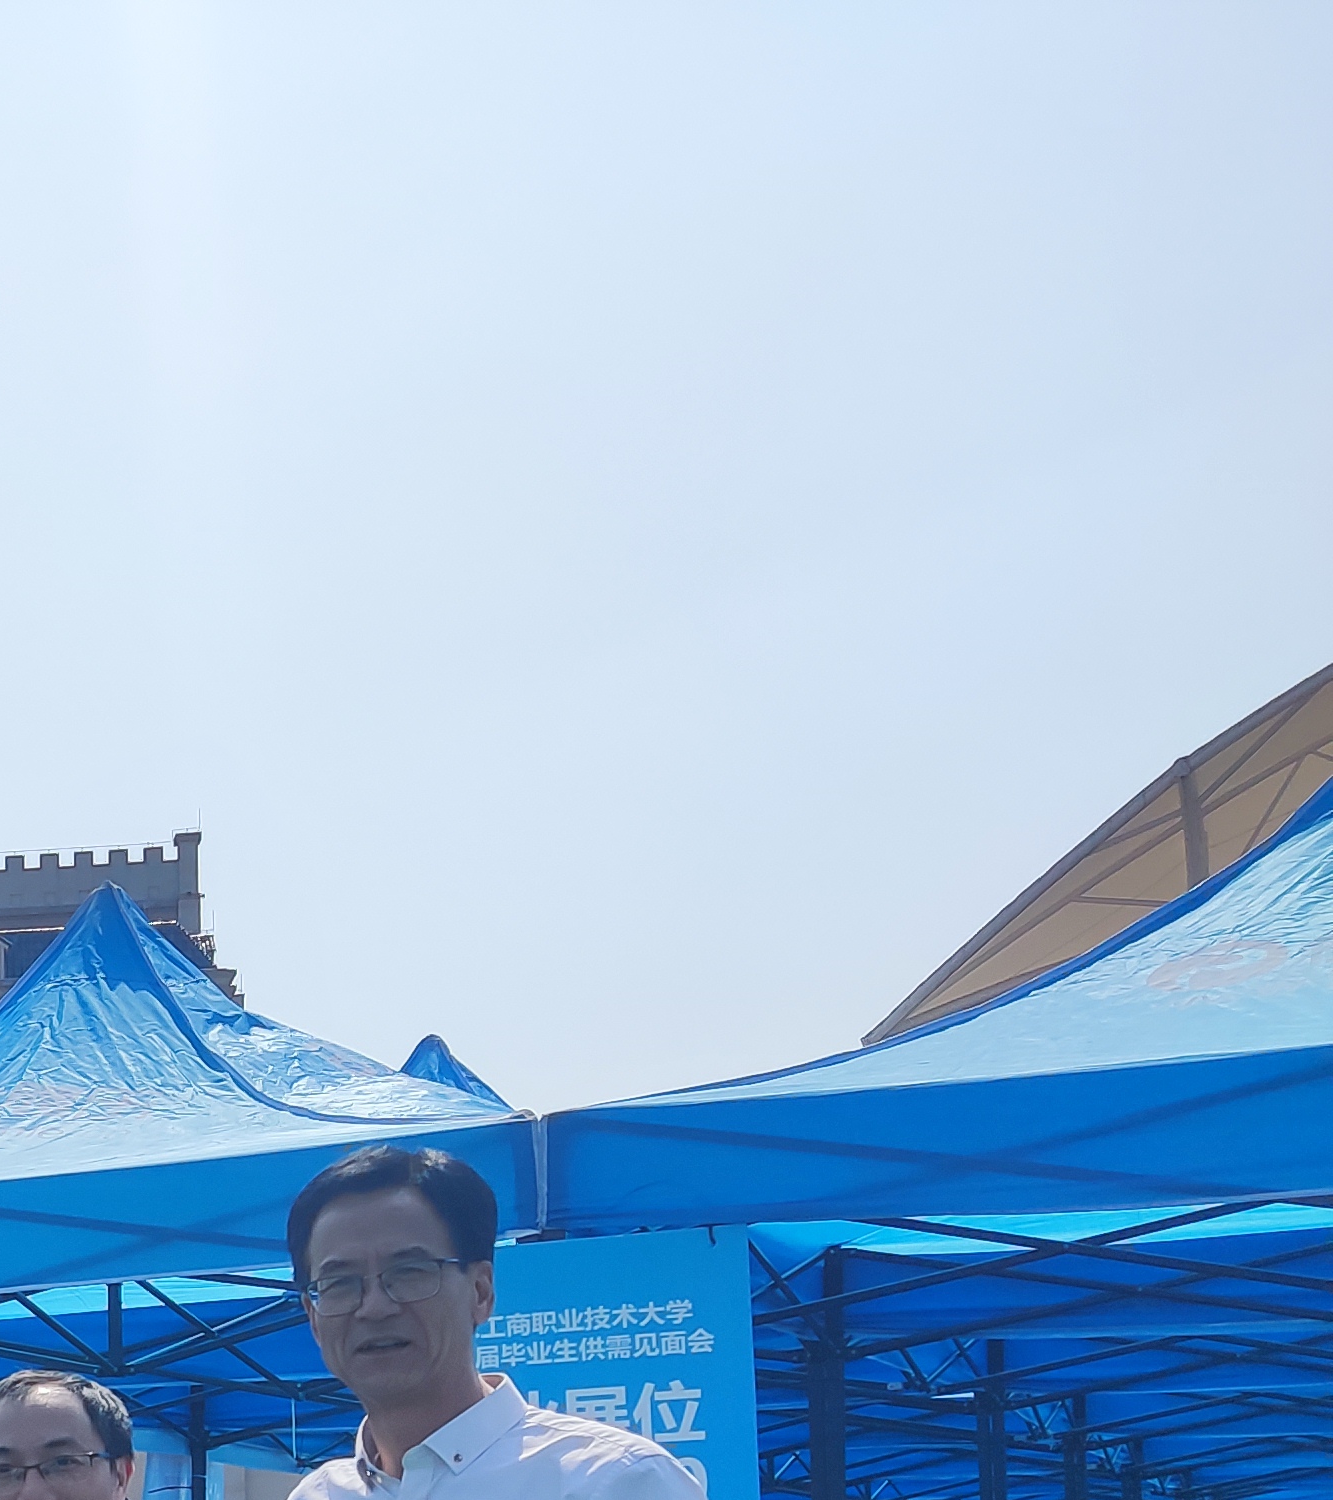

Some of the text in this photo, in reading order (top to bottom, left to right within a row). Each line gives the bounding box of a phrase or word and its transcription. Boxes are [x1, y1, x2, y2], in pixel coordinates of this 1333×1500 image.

[475, 1299, 694, 1339] 工商职业技术大学
[475, 1328, 715, 1370] 届毕业生供需见面会
[527, 1380, 707, 1443] 展位
